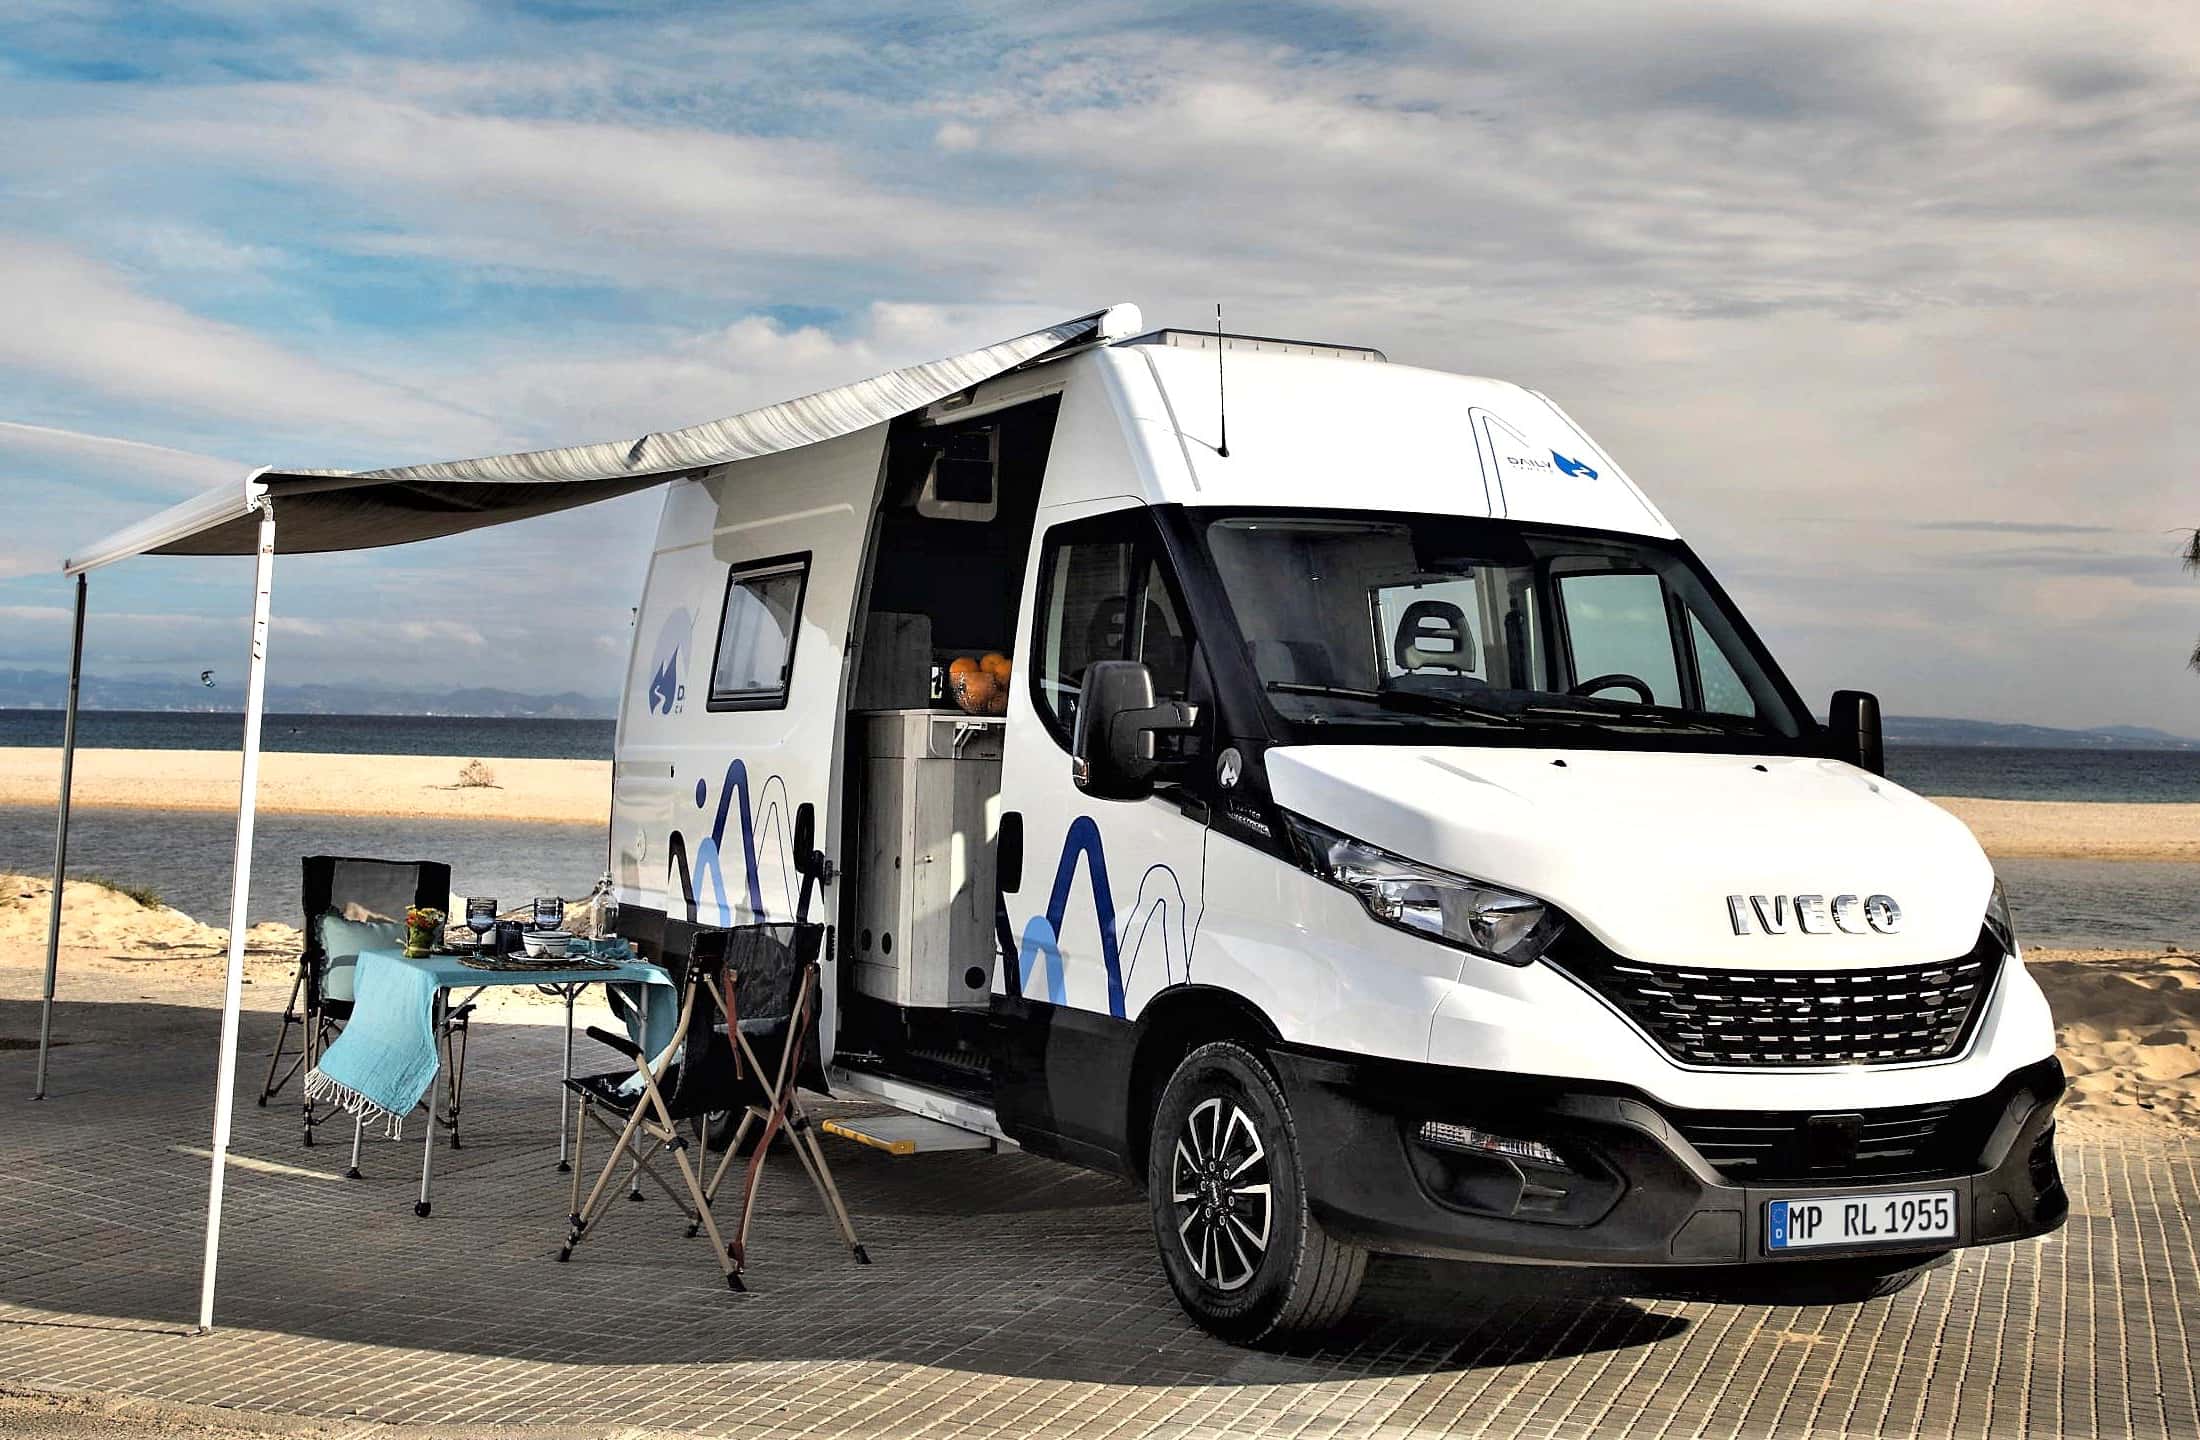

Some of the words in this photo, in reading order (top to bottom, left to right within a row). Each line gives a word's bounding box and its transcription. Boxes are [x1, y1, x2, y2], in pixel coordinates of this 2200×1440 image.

[1726, 894, 1902, 936] IVECO
[1775, 1228, 1783, 1240] D
[1789, 1206, 1822, 1240] MP
[1844, 1203, 1876, 1236] RL
[1884, 1198, 1949, 1233] 1955
